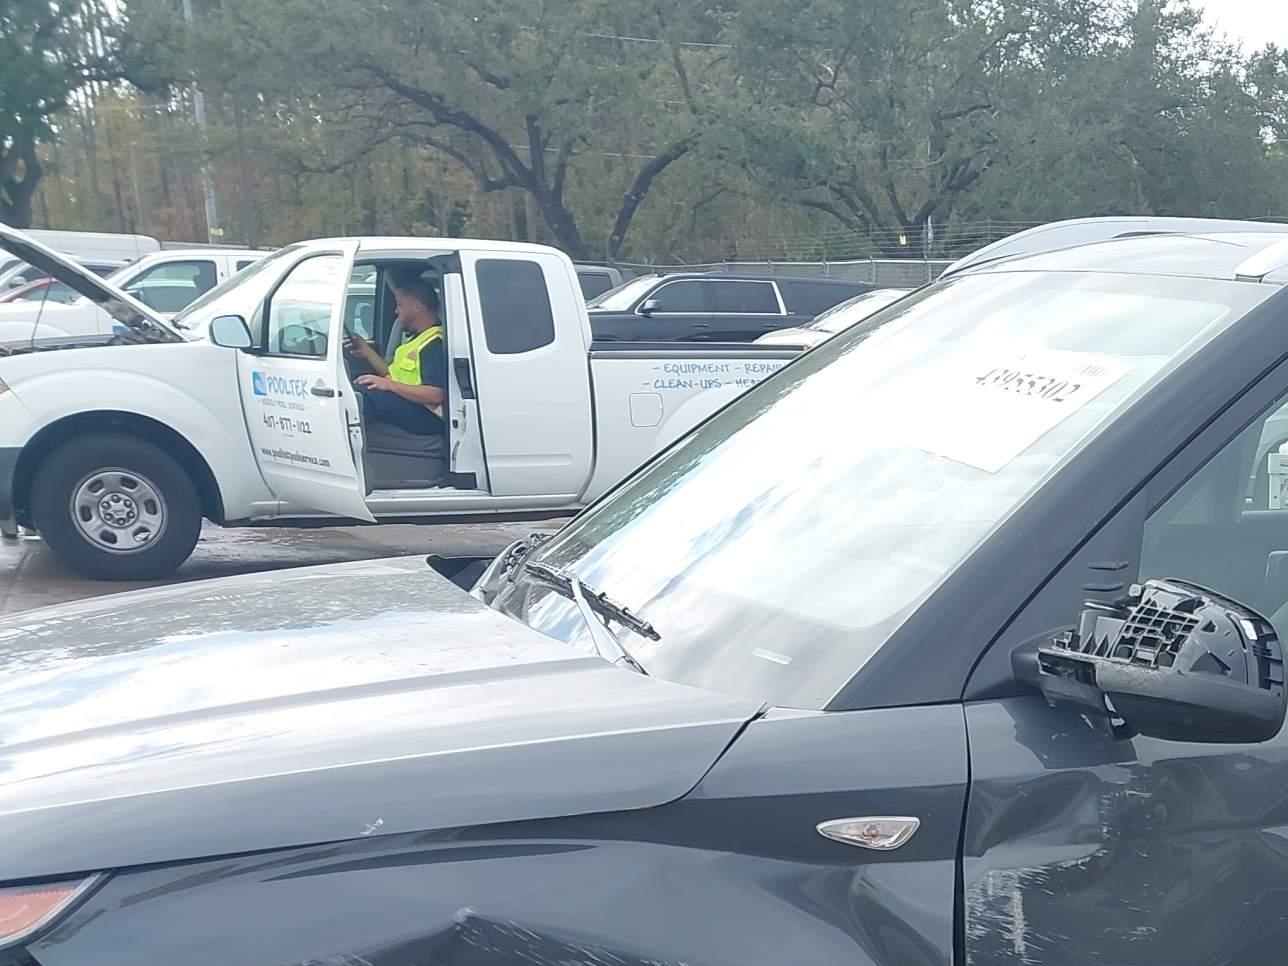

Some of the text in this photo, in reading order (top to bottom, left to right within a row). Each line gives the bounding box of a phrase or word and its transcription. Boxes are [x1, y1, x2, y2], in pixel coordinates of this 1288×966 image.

[663, 363, 730, 376] EQUIPMENT
[266, 375, 309, 398] POOLTEK
[654, 378, 760, 390] CLEAN-UPS HEA
[976, 367, 1081, 402] 43955302
